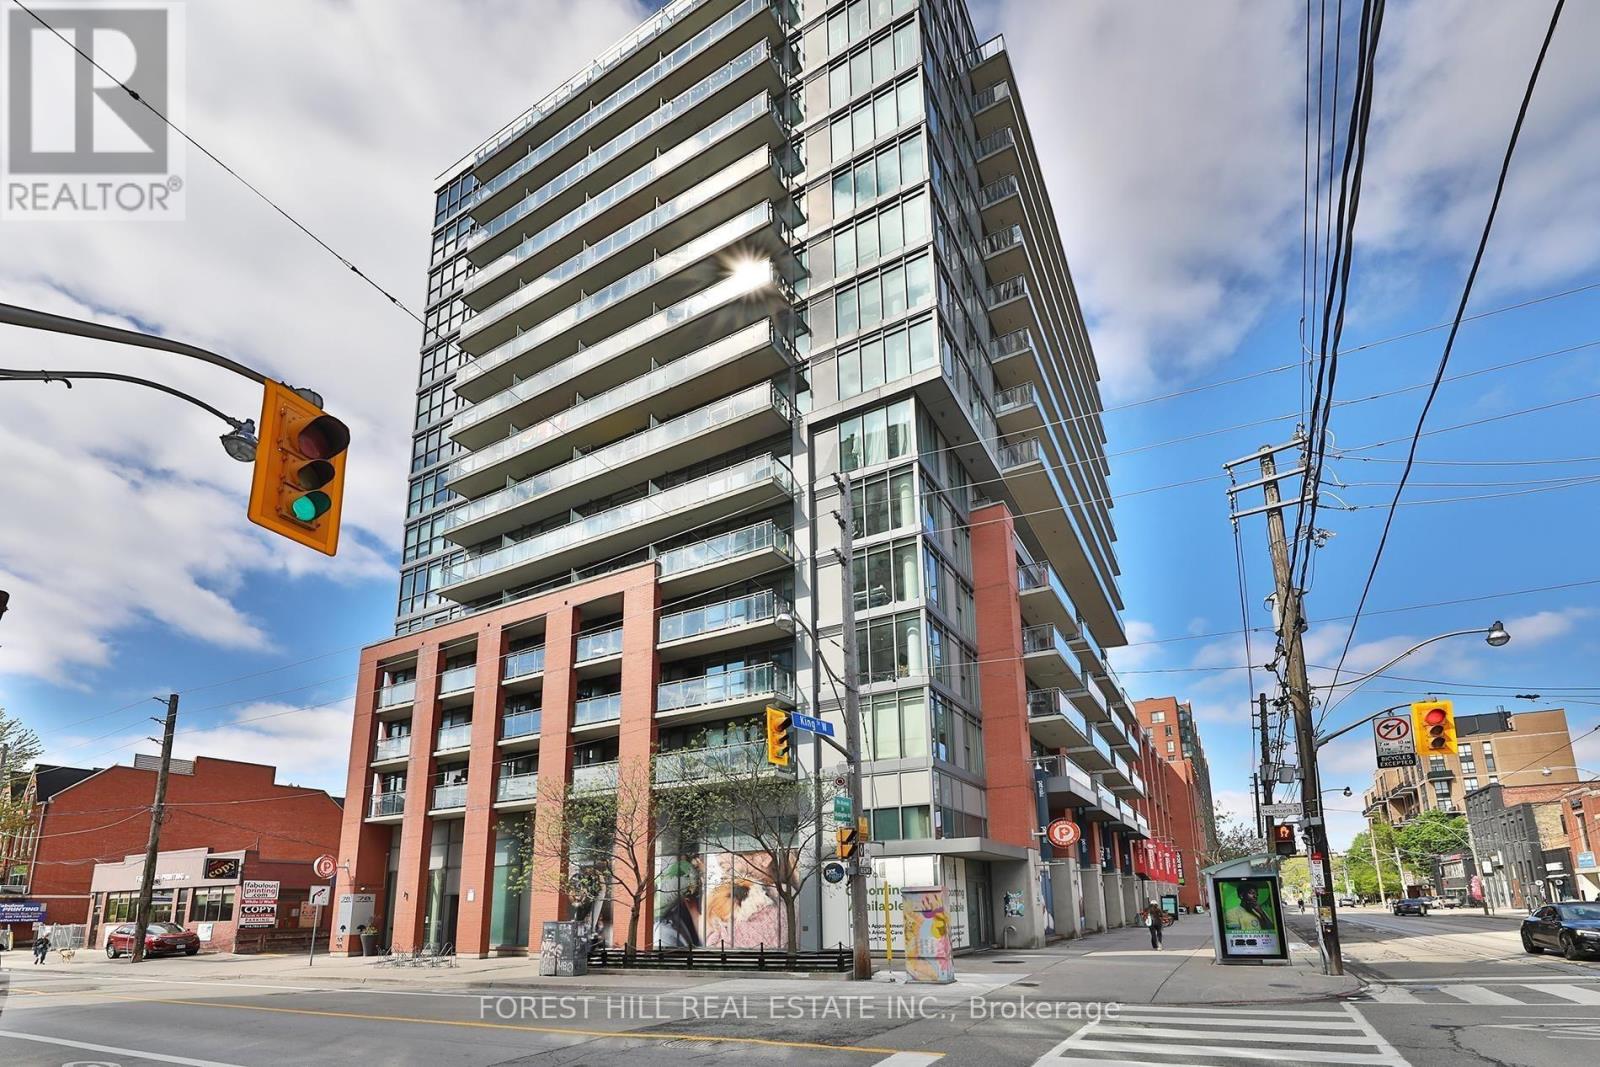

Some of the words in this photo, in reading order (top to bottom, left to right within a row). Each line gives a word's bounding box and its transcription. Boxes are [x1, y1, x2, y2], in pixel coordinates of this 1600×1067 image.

[799, 715, 816, 731] King
[821, 722, 827, 731] W
[1381, 754, 1411, 762] BICYCLES
[208, 861, 235, 878] copy
